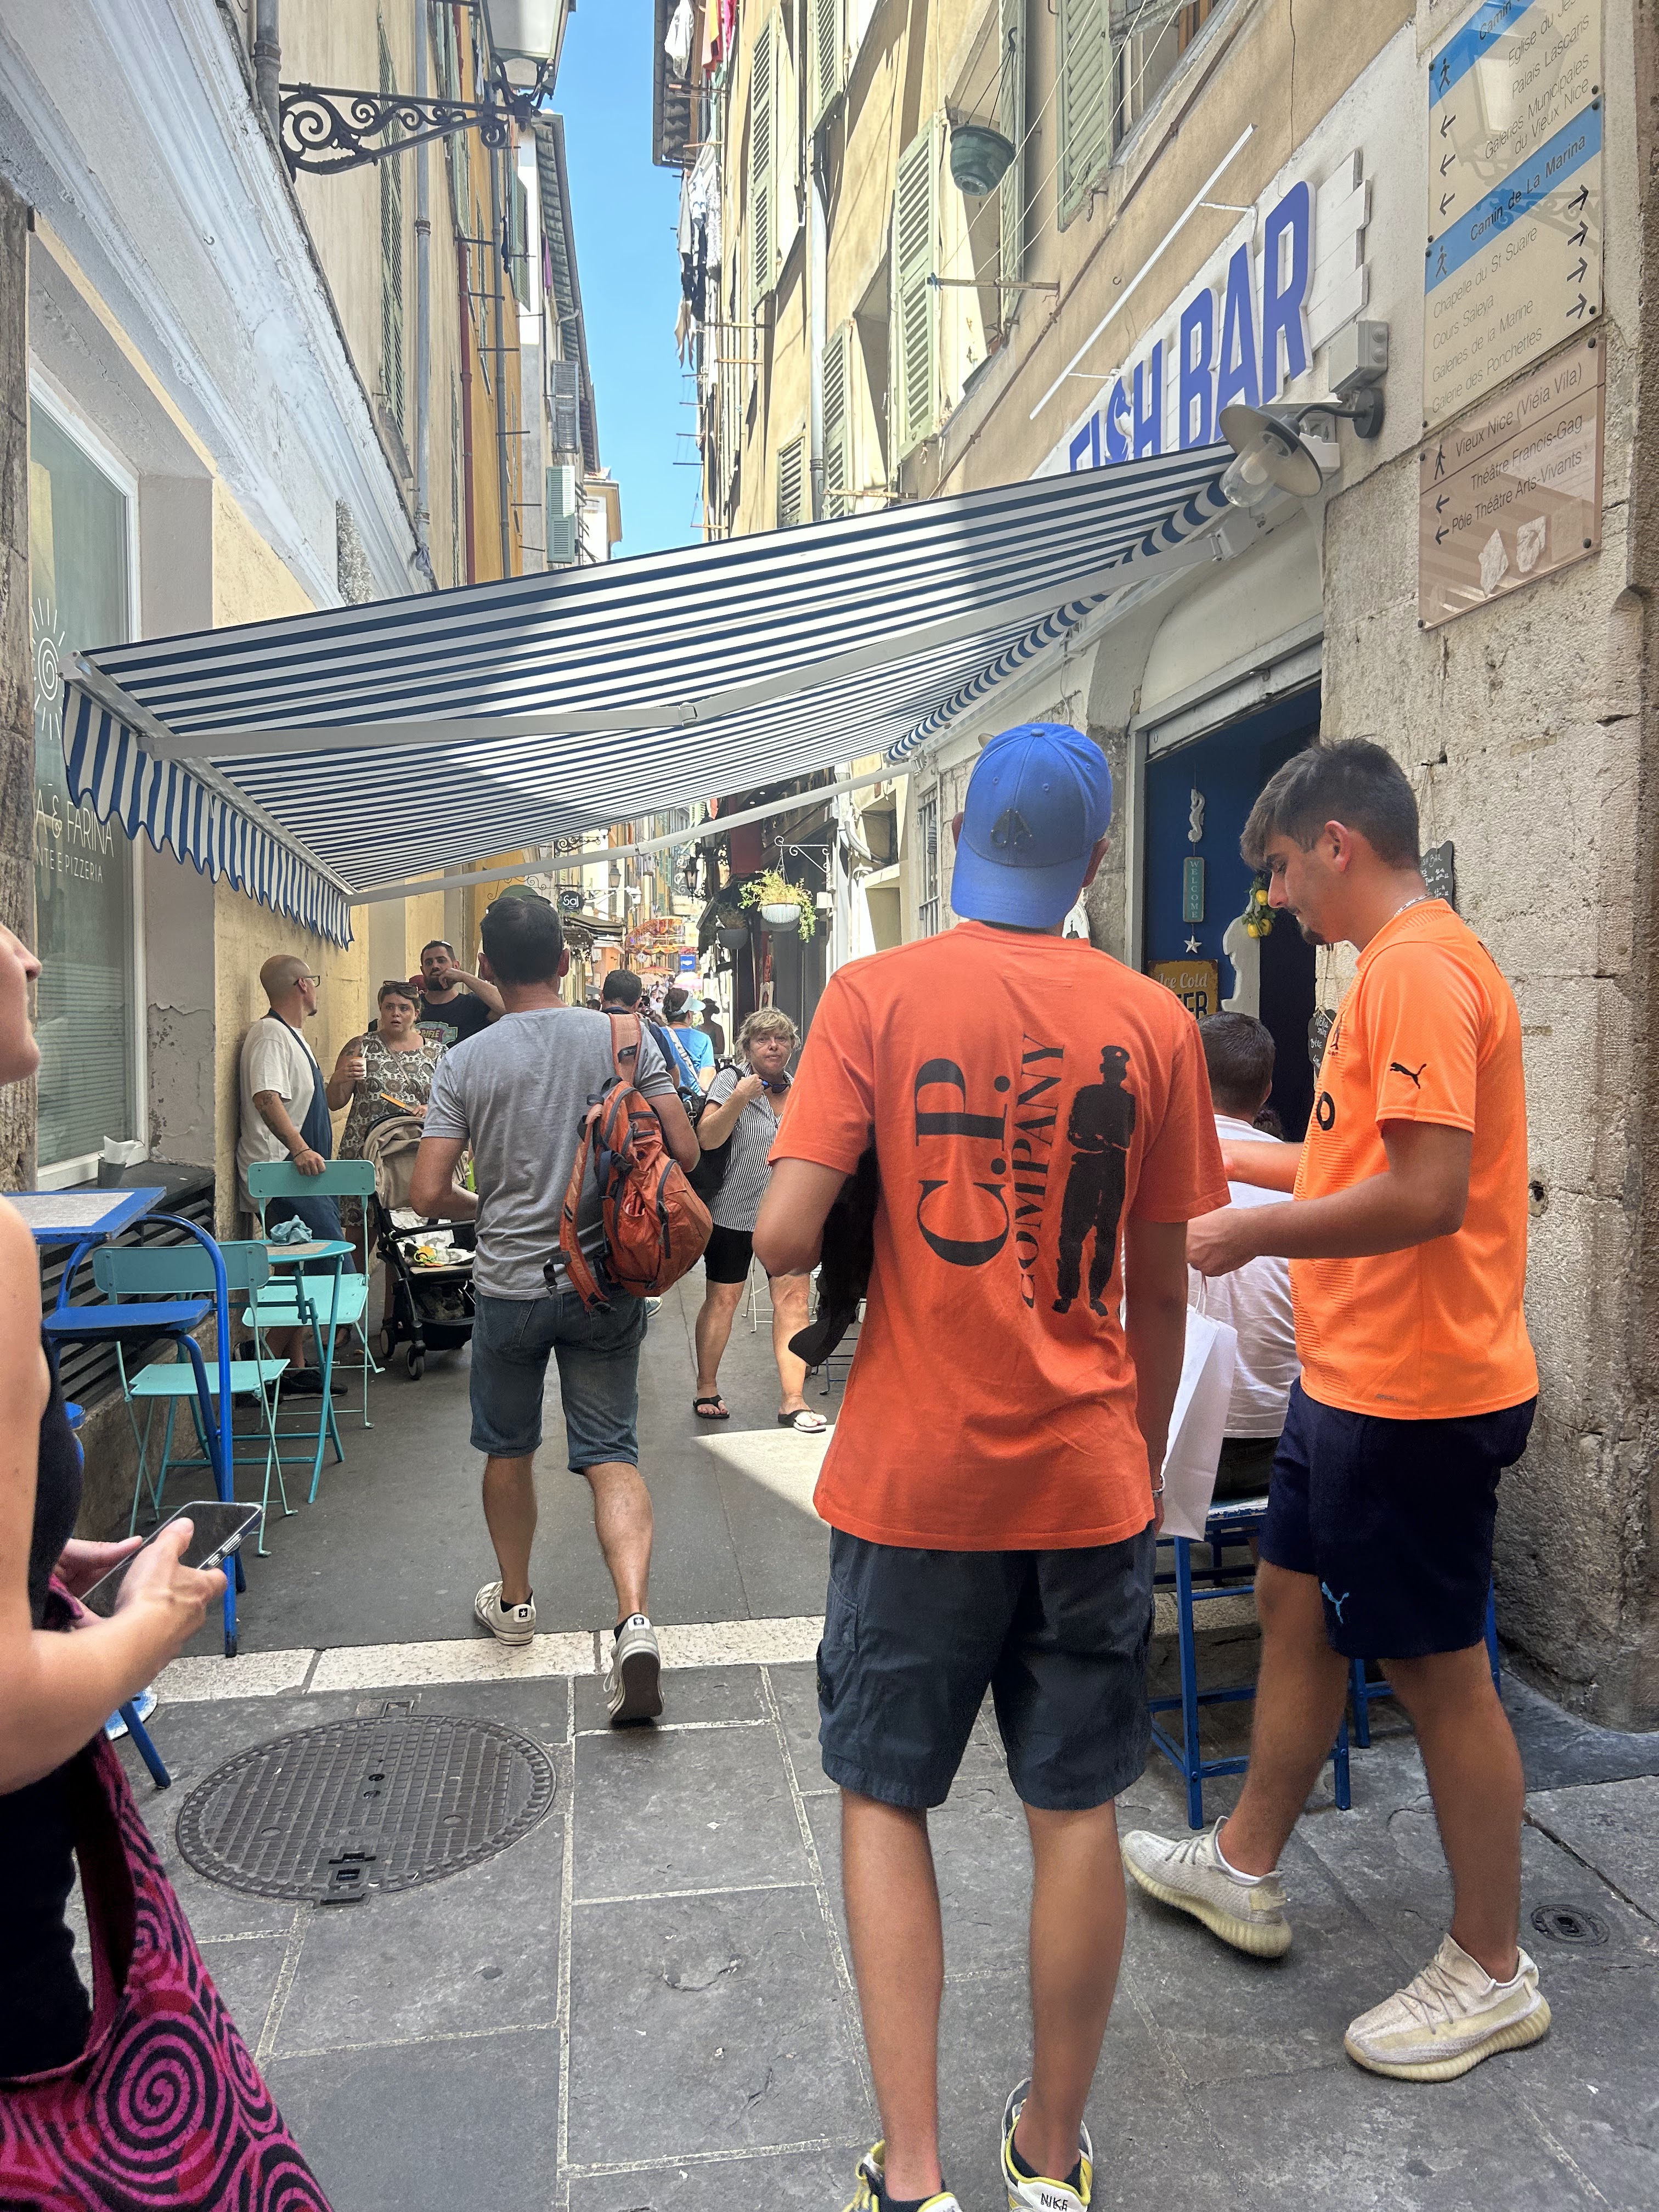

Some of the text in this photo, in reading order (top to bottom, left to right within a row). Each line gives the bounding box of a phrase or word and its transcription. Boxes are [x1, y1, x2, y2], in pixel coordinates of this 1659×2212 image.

[1480, 0, 1512, 41] Camin
[1509, 31, 1536, 67] Eglise
[1541, 13, 1553, 34] du
[1512, 15, 1589, 99] Palais Lascaris
[1486, 54, 1589, 159] Galeries Municipales
[1515, 78, 1588, 155] du Vieux Nice
[1470, 136, 1585, 241] Camin de La Marina
[1434, 228, 1537, 318] Chapelle du St Suaire
[1179, 181, 1316, 452] BAR
[1432, 300, 1533, 382] Galeries de la Marine
[1433, 295, 1494, 349] Cours Saleya
[1432, 328, 1542, 413] Galerie des Ponchettes
[1455, 429, 1484, 457] Vieux
[1487, 411, 1514, 438] Nice
[1554, 362, 1582, 393] Vila)
[1471, 414, 1583, 490] Théâtre Francis-Gag
[1452, 451, 1582, 534] Pôle Théâtre Arts-Vivants
[52, 794, 63, 838] &
[67, 800, 114, 857] FARINA
[58, 851, 63, 872] E
[65, 854, 103, 883] PIZZERIA
[562, 894, 579, 907] Saj
[1189, 860, 1200, 918] WELCOME
[1176, 990, 1207, 1020] ER
[1180, 972, 1208, 989] Cold
[914, 1058, 1009, 1267] C.P.
[1011, 1032, 1065, 1309] COMPANY
[1041, 2192, 1068, 2212] NIKE
